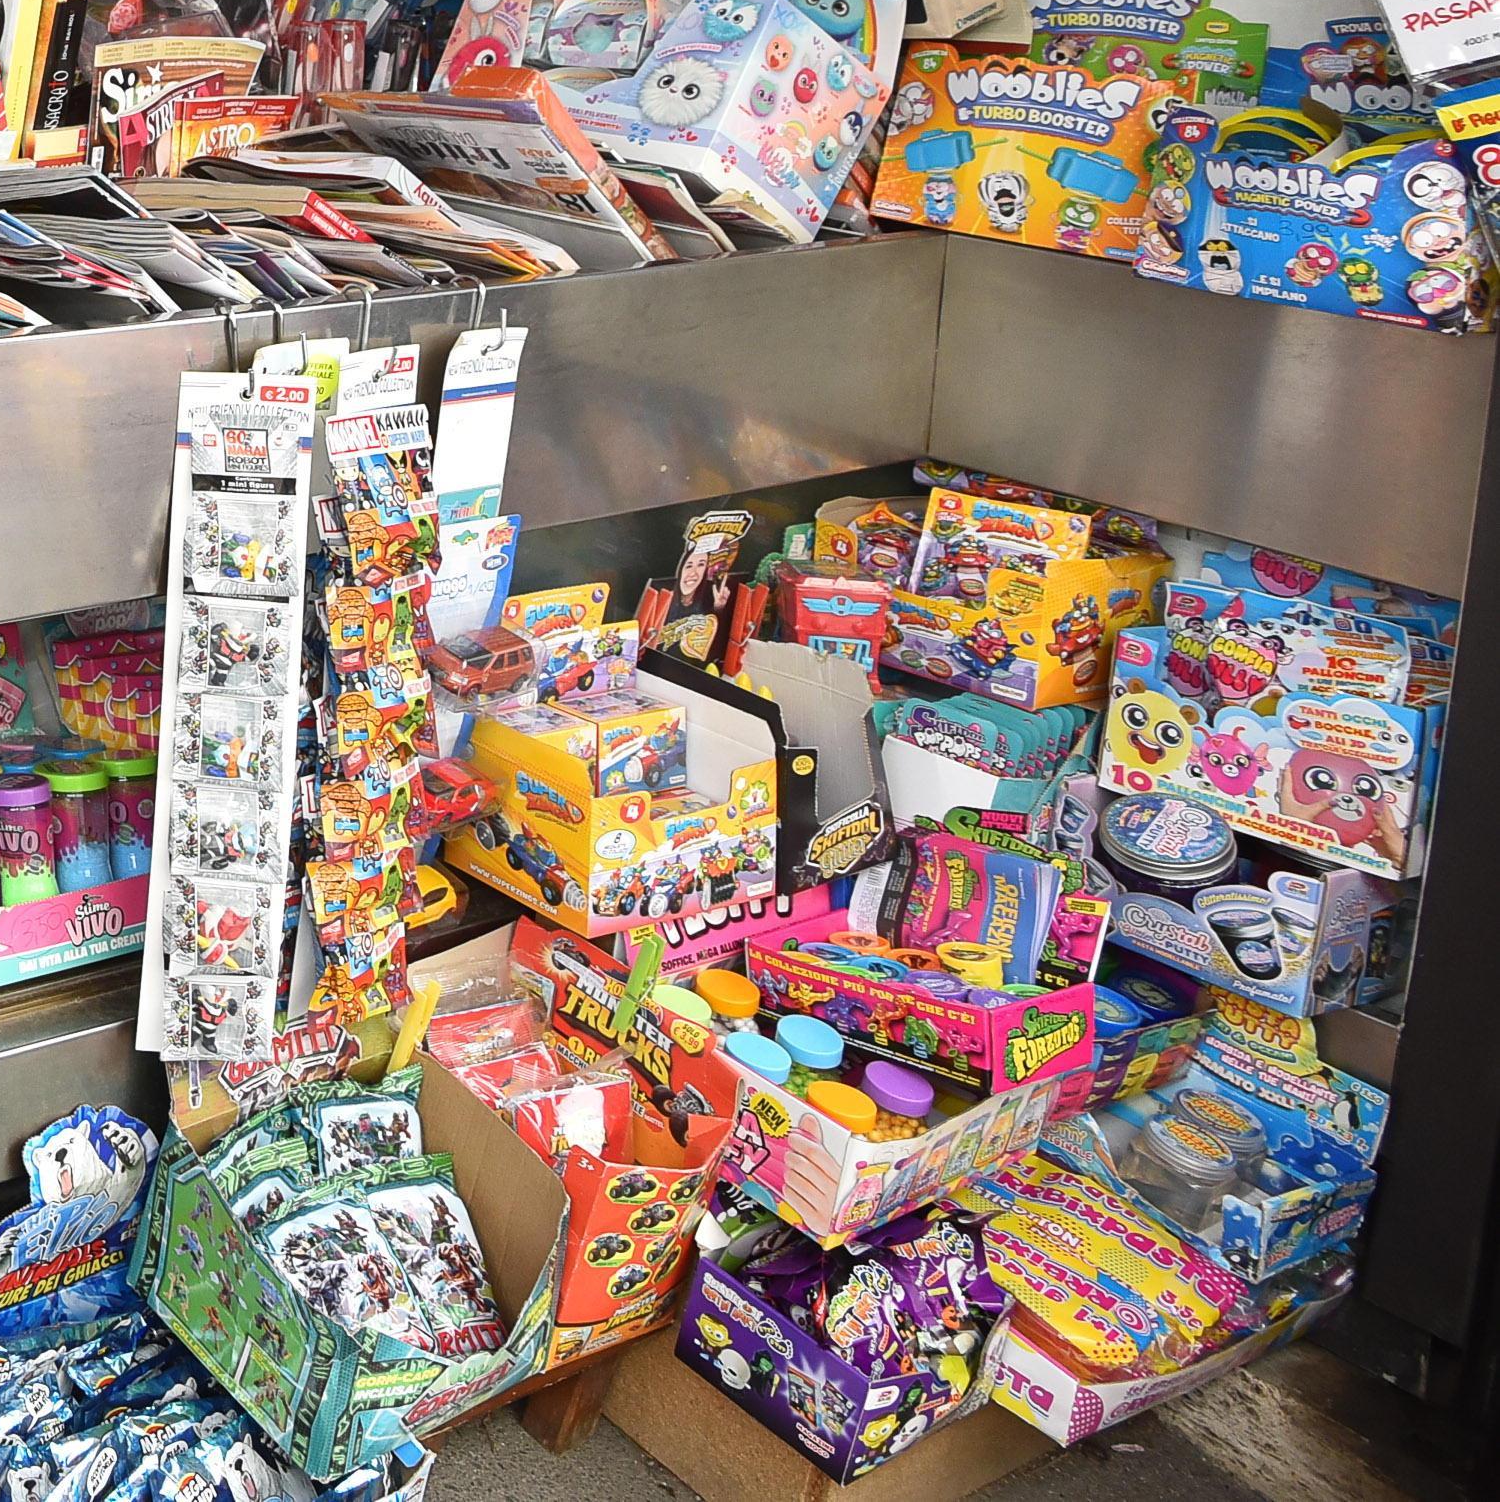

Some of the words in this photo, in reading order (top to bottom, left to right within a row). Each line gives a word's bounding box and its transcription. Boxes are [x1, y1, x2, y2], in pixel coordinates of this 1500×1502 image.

[1046, 12, 1098, 27] TURBO
[1102, 15, 1180, 35] BOOSTER
[974, 104, 1025, 123] TURBO
[1027, 112, 1110, 138] BOOSTER
[1234, 193, 1289, 206] MAGNETIC
[1293, 203, 1340, 217] POWER
[1252, 285, 1307, 303] IMPILANO
[1111, 765, 1152, 791] 10
[1157, 779, 1248, 817] PALLONCINI
[1265, 811, 1335, 840] BUSTINA
[65, 905, 123, 945] VIVO
[66, 1252, 125, 1284] GHIACCI
